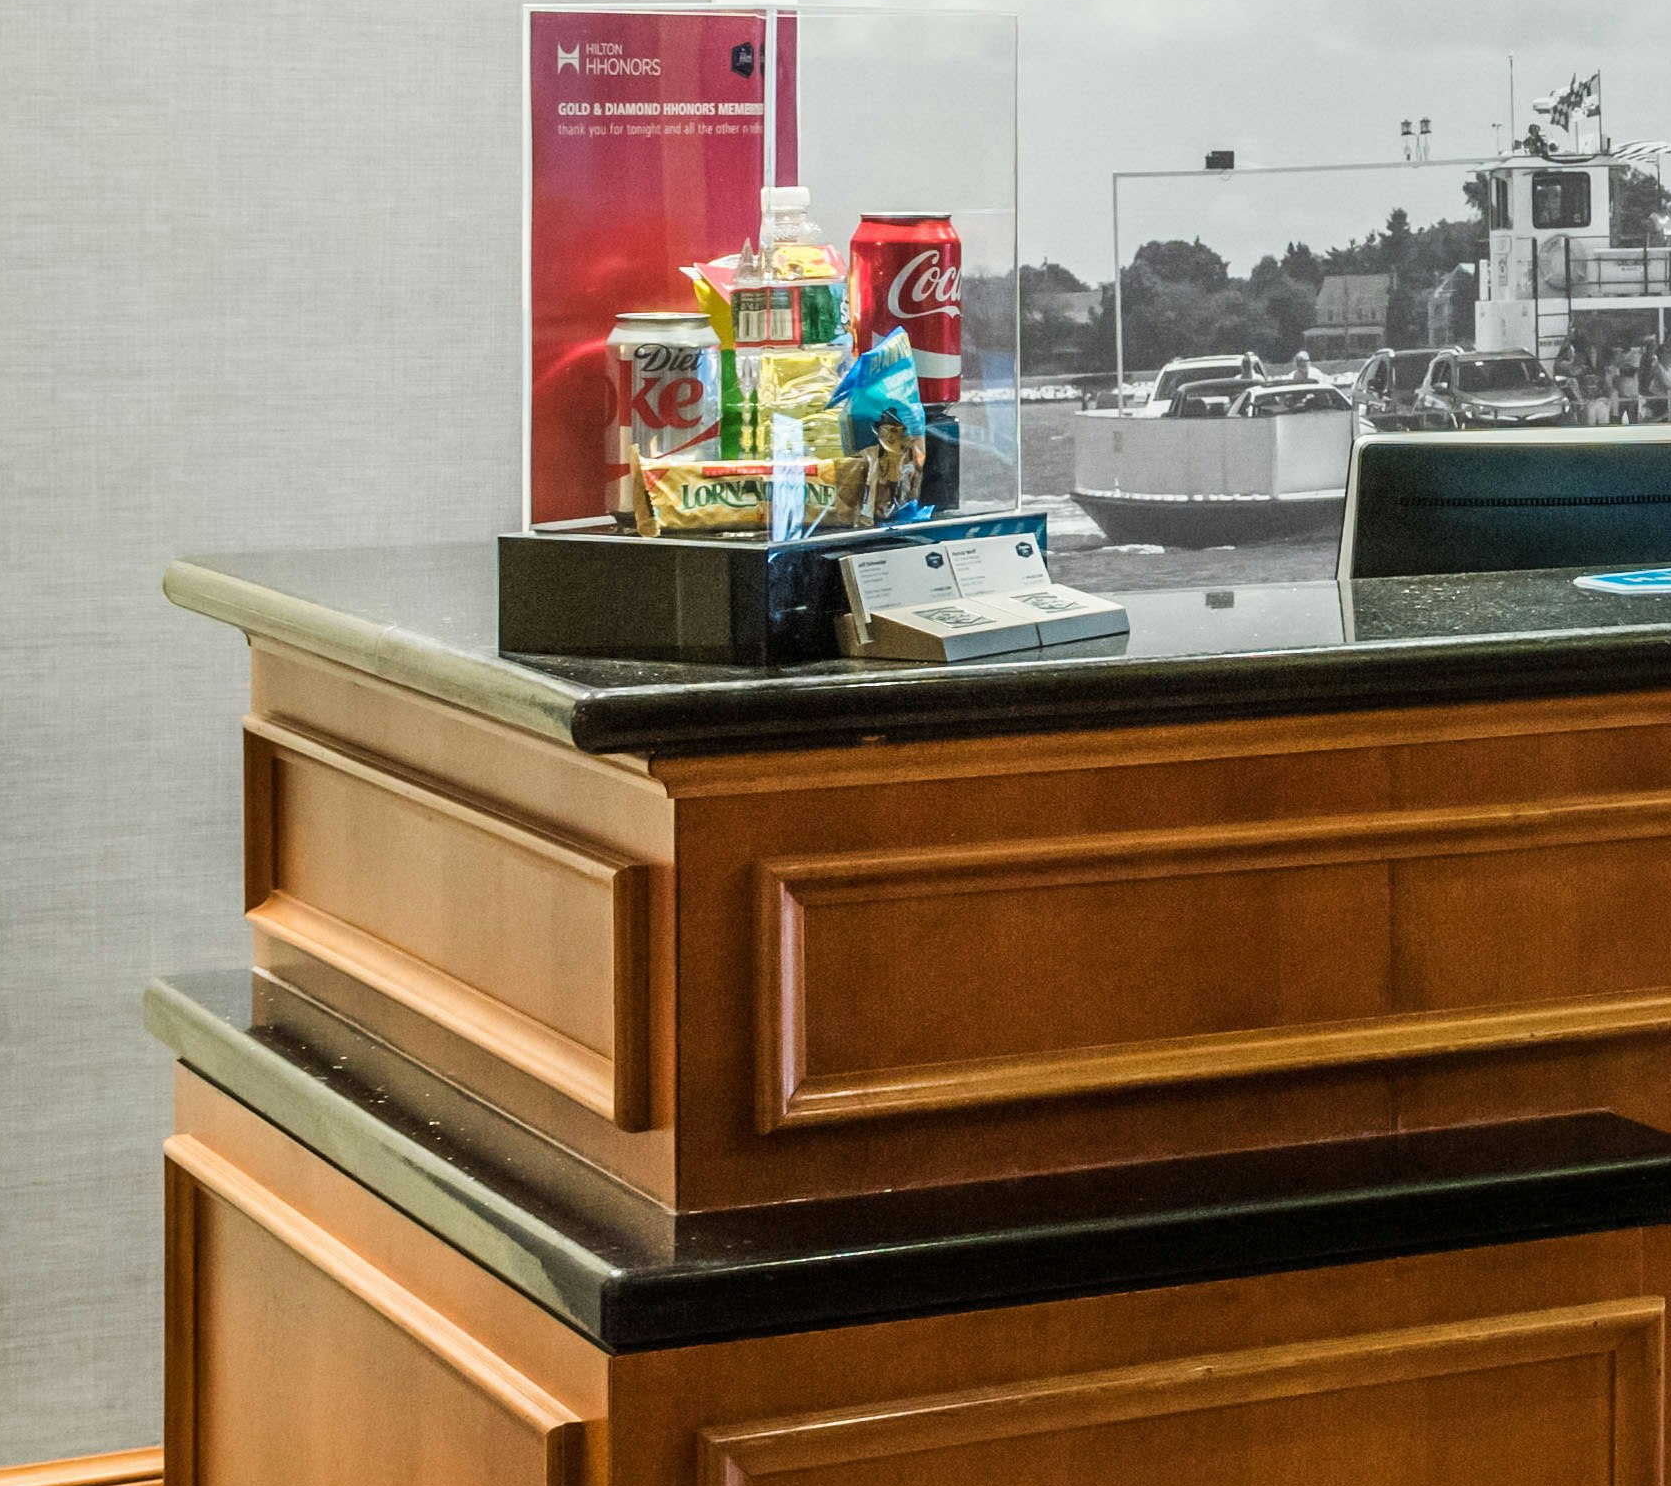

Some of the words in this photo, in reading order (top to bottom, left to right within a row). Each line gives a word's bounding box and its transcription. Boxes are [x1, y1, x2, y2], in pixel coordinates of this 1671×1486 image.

[586, 43, 623, 56] HILTON
[586, 58, 661, 76] HHONORS
[558, 102, 590, 115] GOLD
[593, 103, 602, 115] &
[605, 102, 659, 115] DIAMOND
[663, 102, 715, 115] HHONORS
[558, 122, 585, 134] thank
[589, 125, 606, 137] you
[610, 122, 623, 134] for
[627, 122, 661, 137] tonight
[664, 122, 681, 134] and
[685, 122, 696, 134] all
[698, 122, 713, 134] the
[716, 122, 740, 134] other
[634, 343, 704, 373] Diet
[681, 479, 763, 510] LORNA
